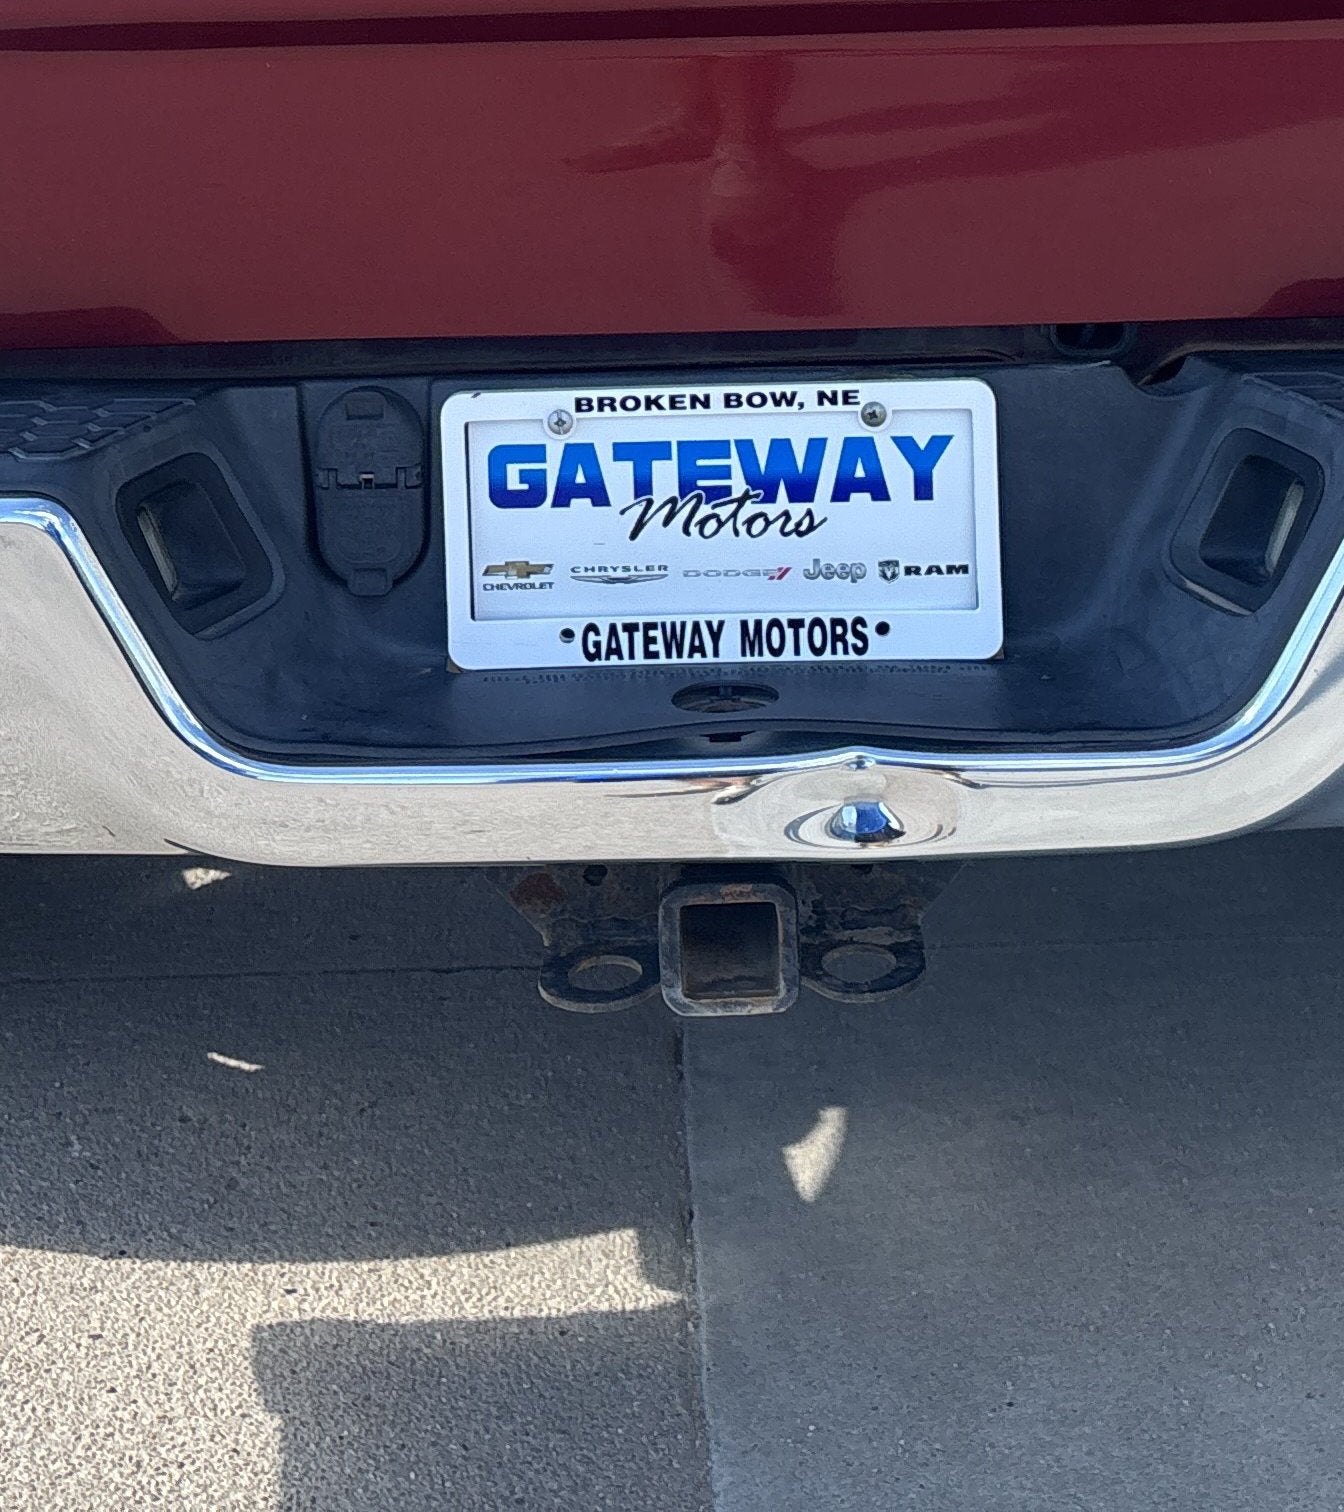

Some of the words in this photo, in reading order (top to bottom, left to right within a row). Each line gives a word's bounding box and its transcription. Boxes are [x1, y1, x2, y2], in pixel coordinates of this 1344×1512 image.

[574, 392, 712, 414] BROKEN
[723, 390, 806, 412] BOW,
[817, 388, 861, 408] NE
[487, 434, 955, 509] GATEWAY
[619, 488, 828, 541] Motors
[569, 564, 670, 574] CHRYSLER
[682, 568, 780, 578] DODGE
[802, 558, 867, 583] Jeep
[903, 563, 970, 576] RAM
[482, 581, 555, 592] CHEVROLET
[581, 620, 727, 662] GATEWAY
[740, 615, 869, 658] MOTORS
